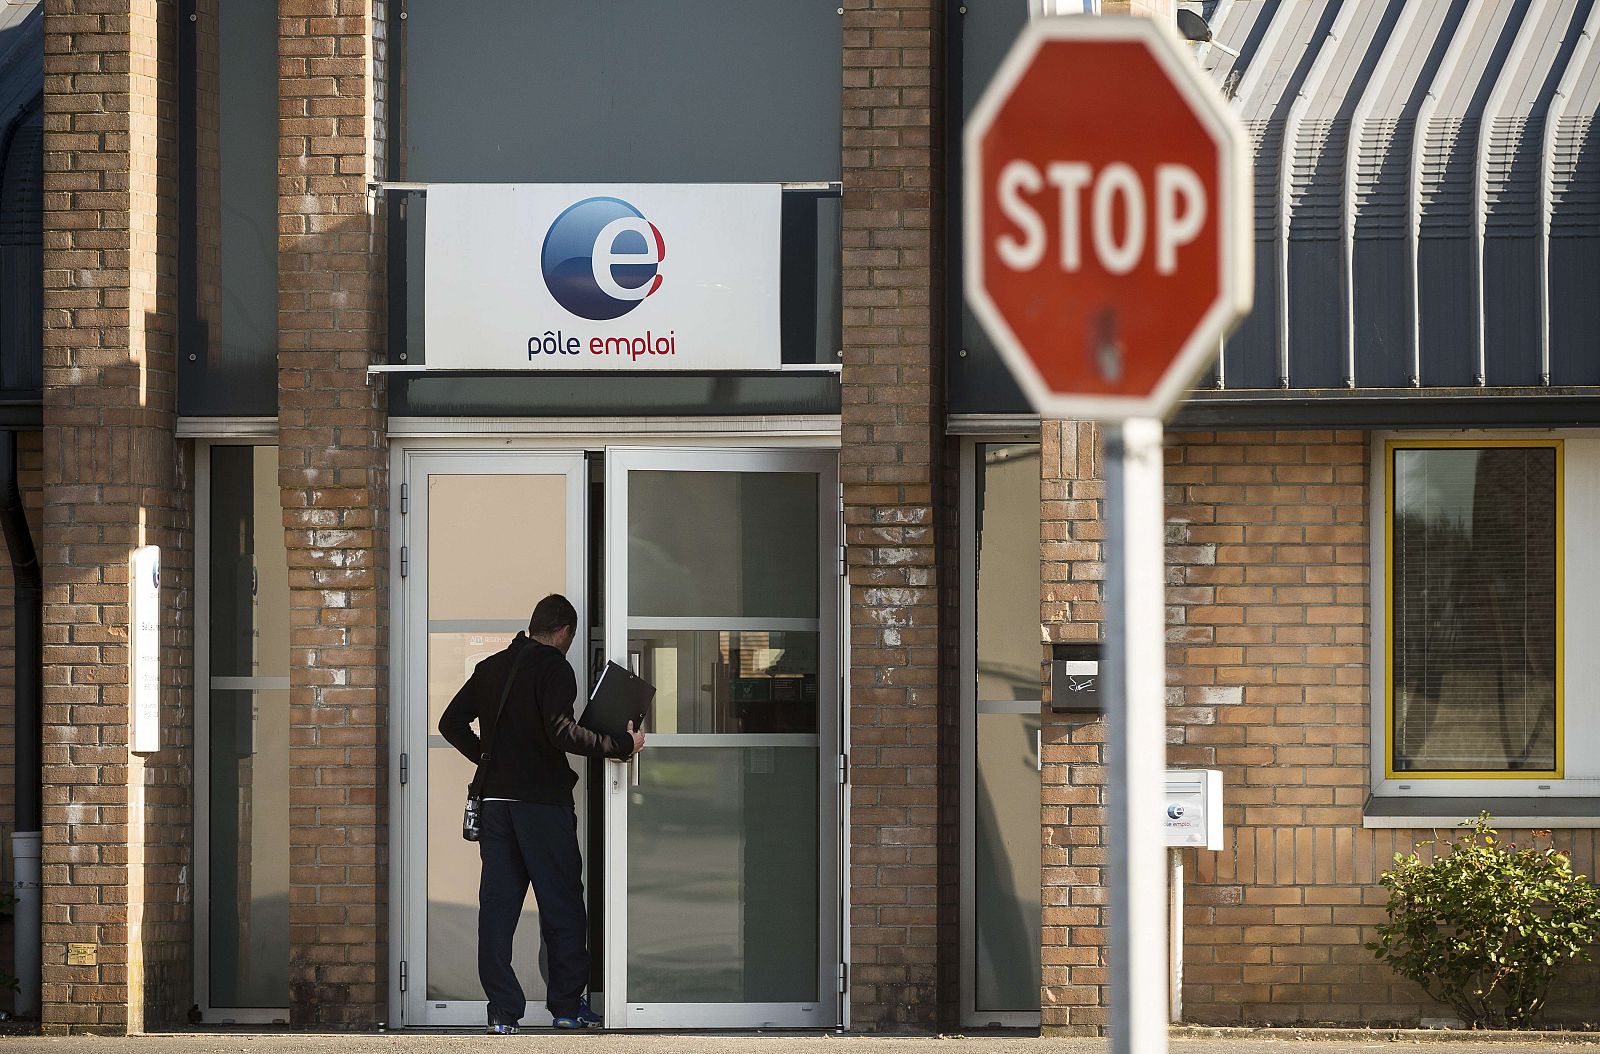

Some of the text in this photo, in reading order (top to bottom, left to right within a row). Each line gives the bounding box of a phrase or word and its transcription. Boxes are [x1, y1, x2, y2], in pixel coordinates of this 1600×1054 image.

[997, 160, 1206, 276] STOP
[527, 330, 676, 361] pôle emploi
